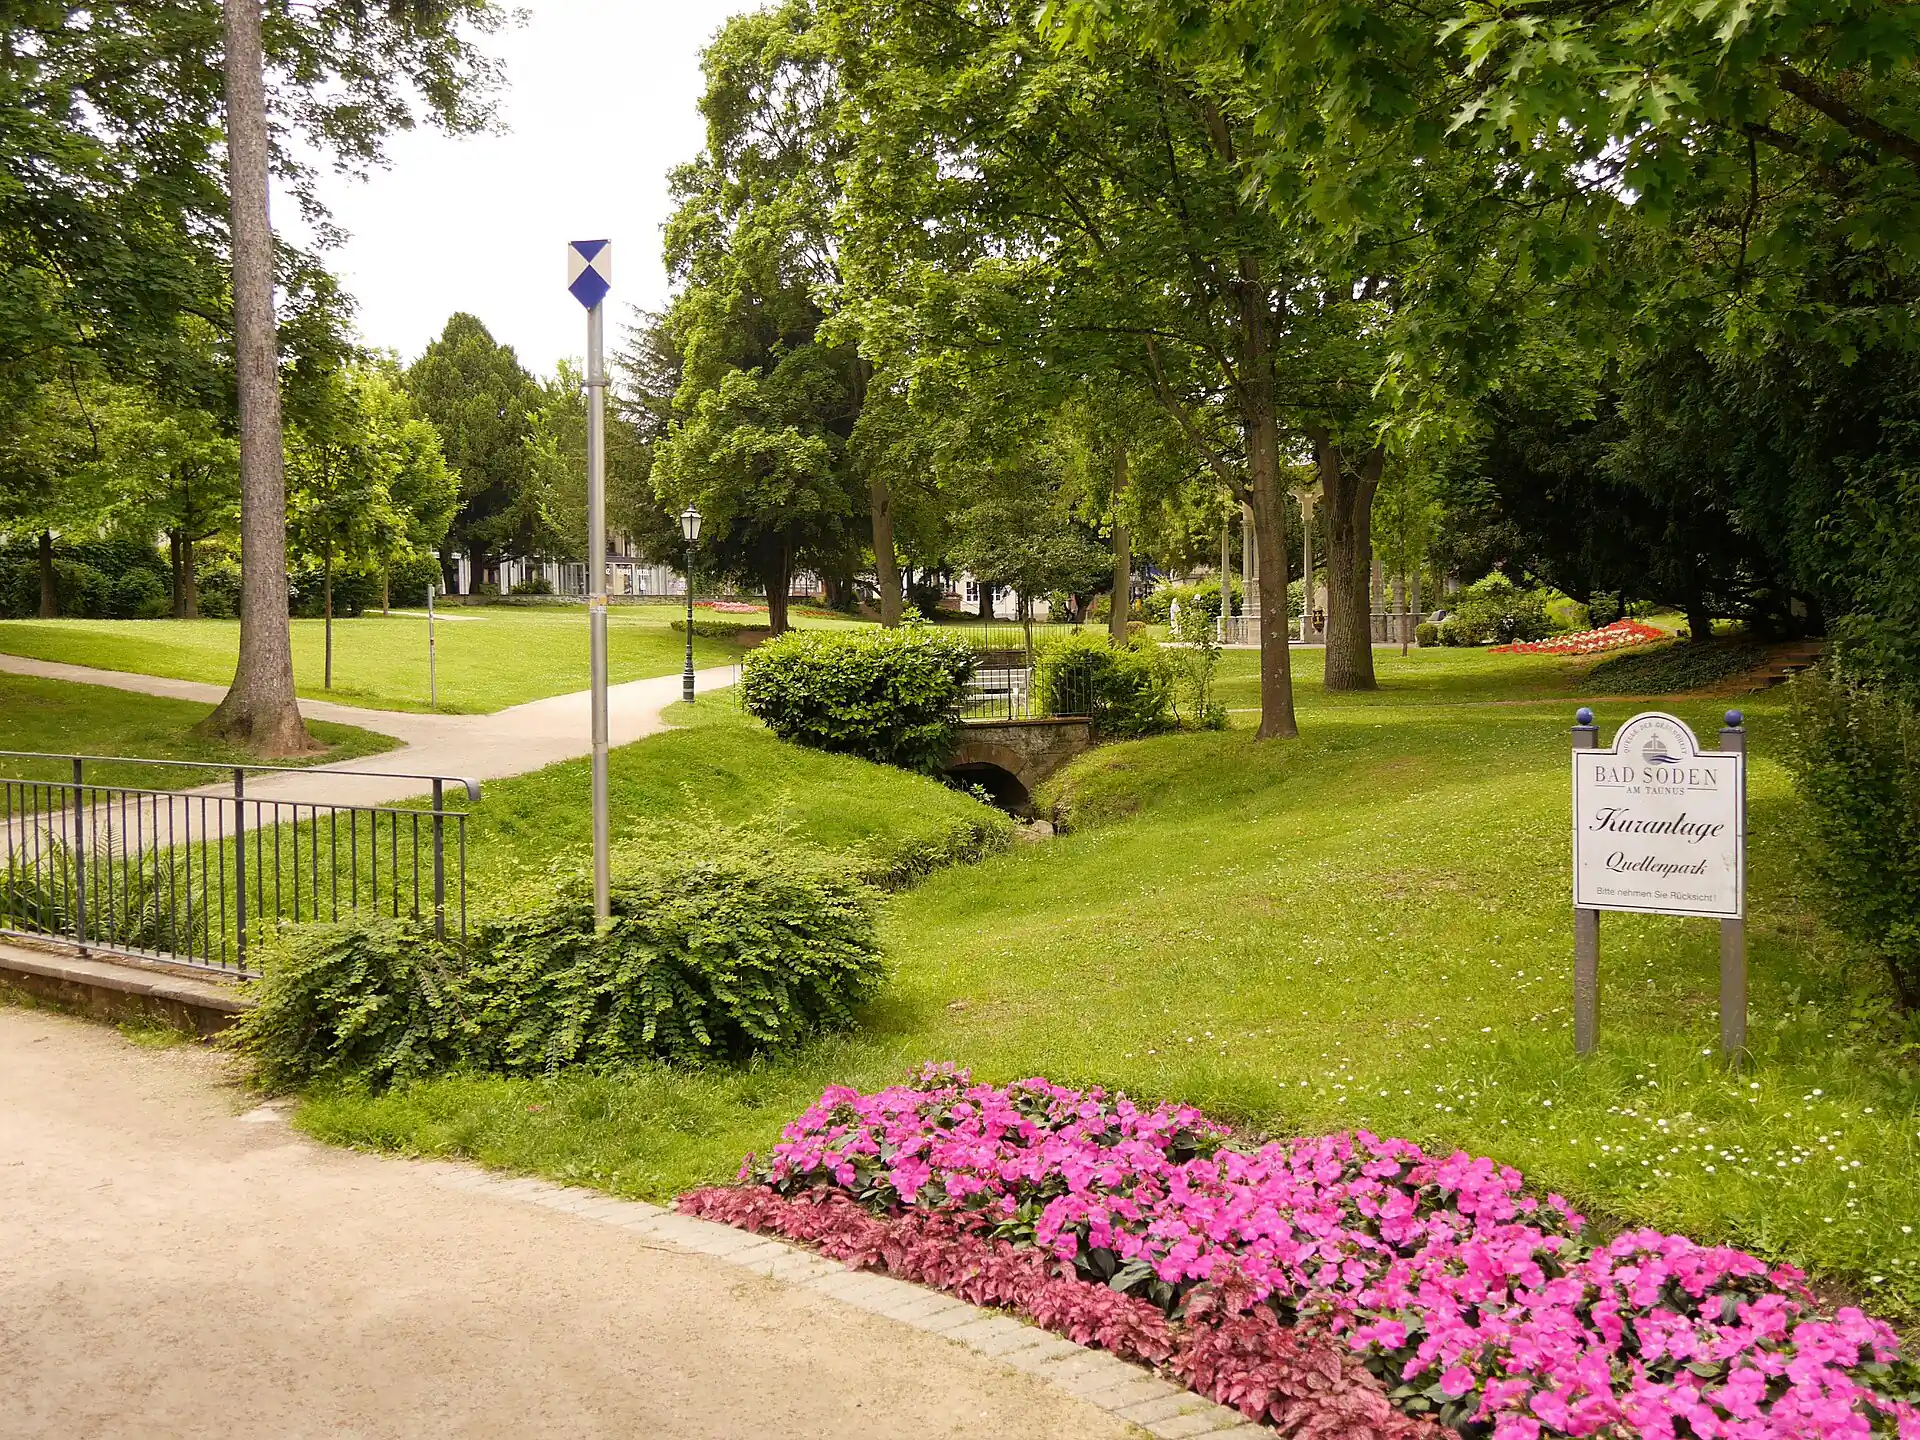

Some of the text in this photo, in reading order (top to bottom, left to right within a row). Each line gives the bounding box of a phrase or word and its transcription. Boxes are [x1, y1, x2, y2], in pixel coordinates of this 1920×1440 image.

[1595, 765, 1718, 786] BAD SODEN
[1626, 786, 1685, 796] AM TAUNUS
[1589, 807, 1724, 844] Kuranlage
[1605, 851, 1708, 879] Quellenpark
[1596, 887, 1615, 896] Bitte
[1617, 888, 1652, 898] nehmen
[1654, 890, 1668, 899] Sie
